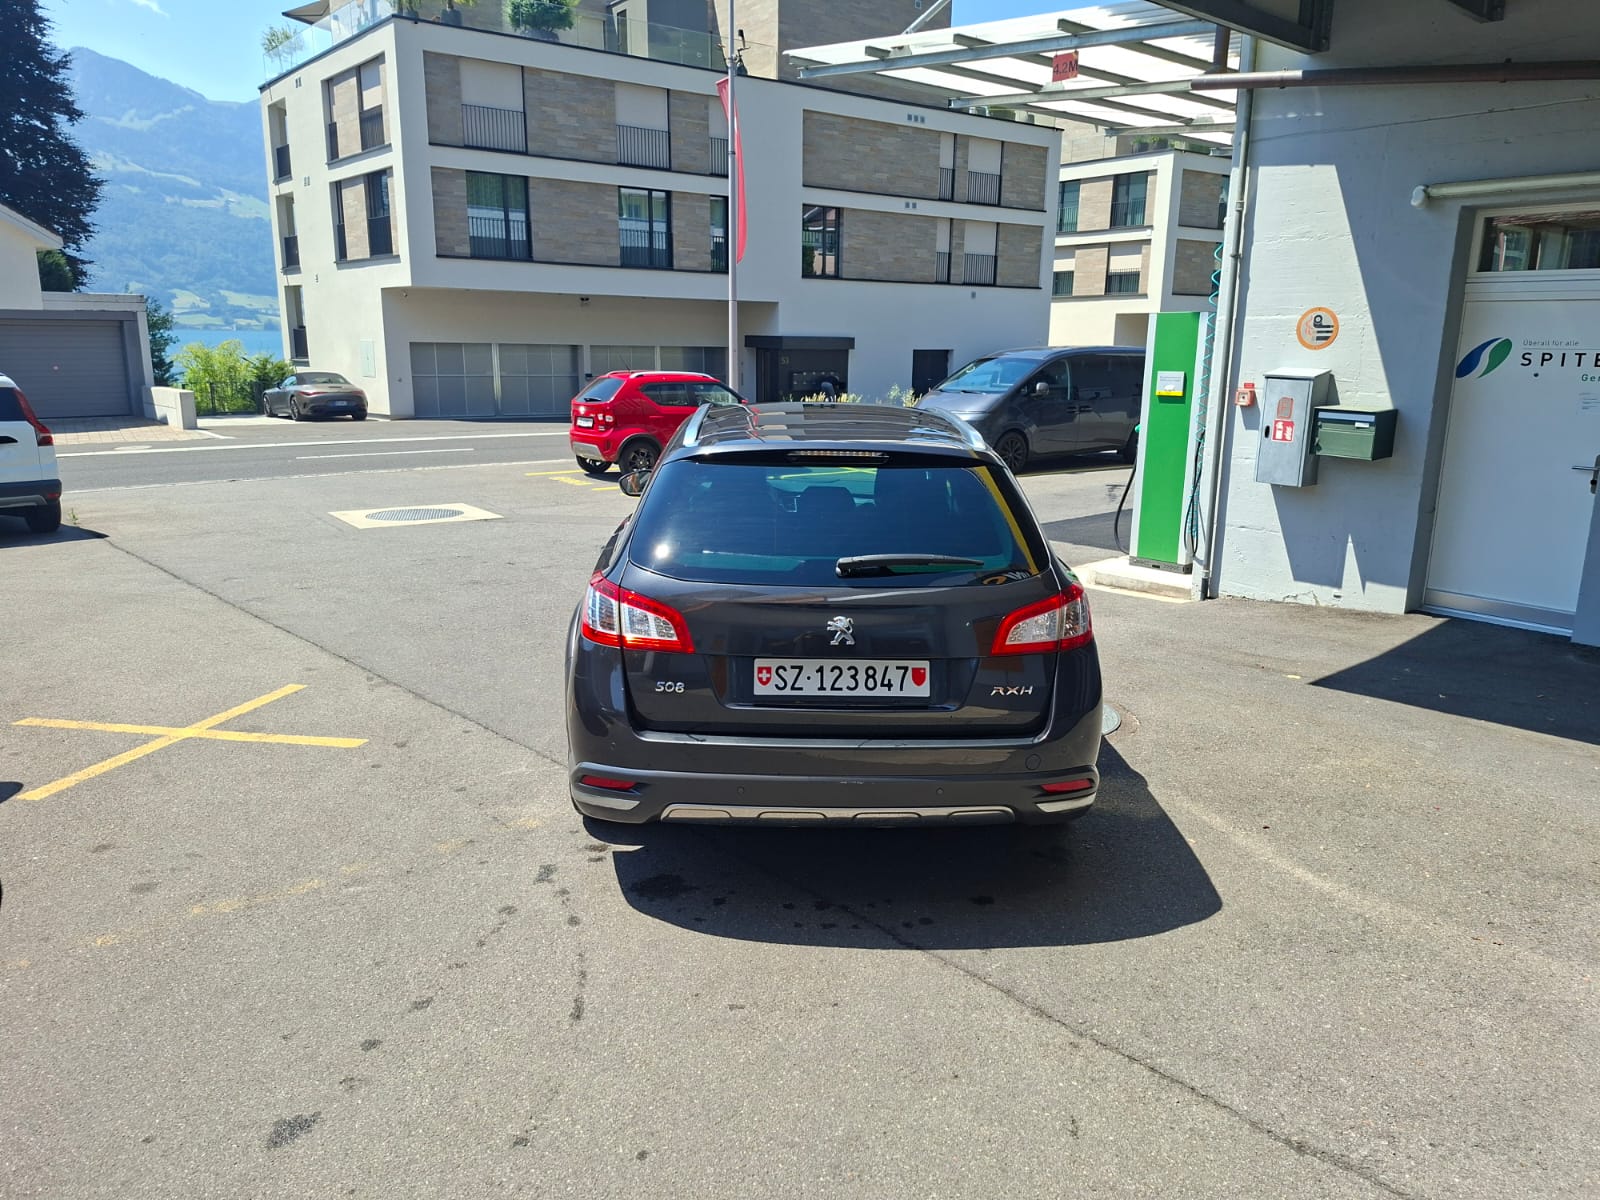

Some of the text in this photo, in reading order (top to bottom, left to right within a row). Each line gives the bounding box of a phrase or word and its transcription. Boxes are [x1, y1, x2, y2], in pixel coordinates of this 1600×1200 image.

[1053, 60, 1078, 75] 4.2M
[655, 681, 685, 693] 508
[990, 686, 1033, 696] RXH
